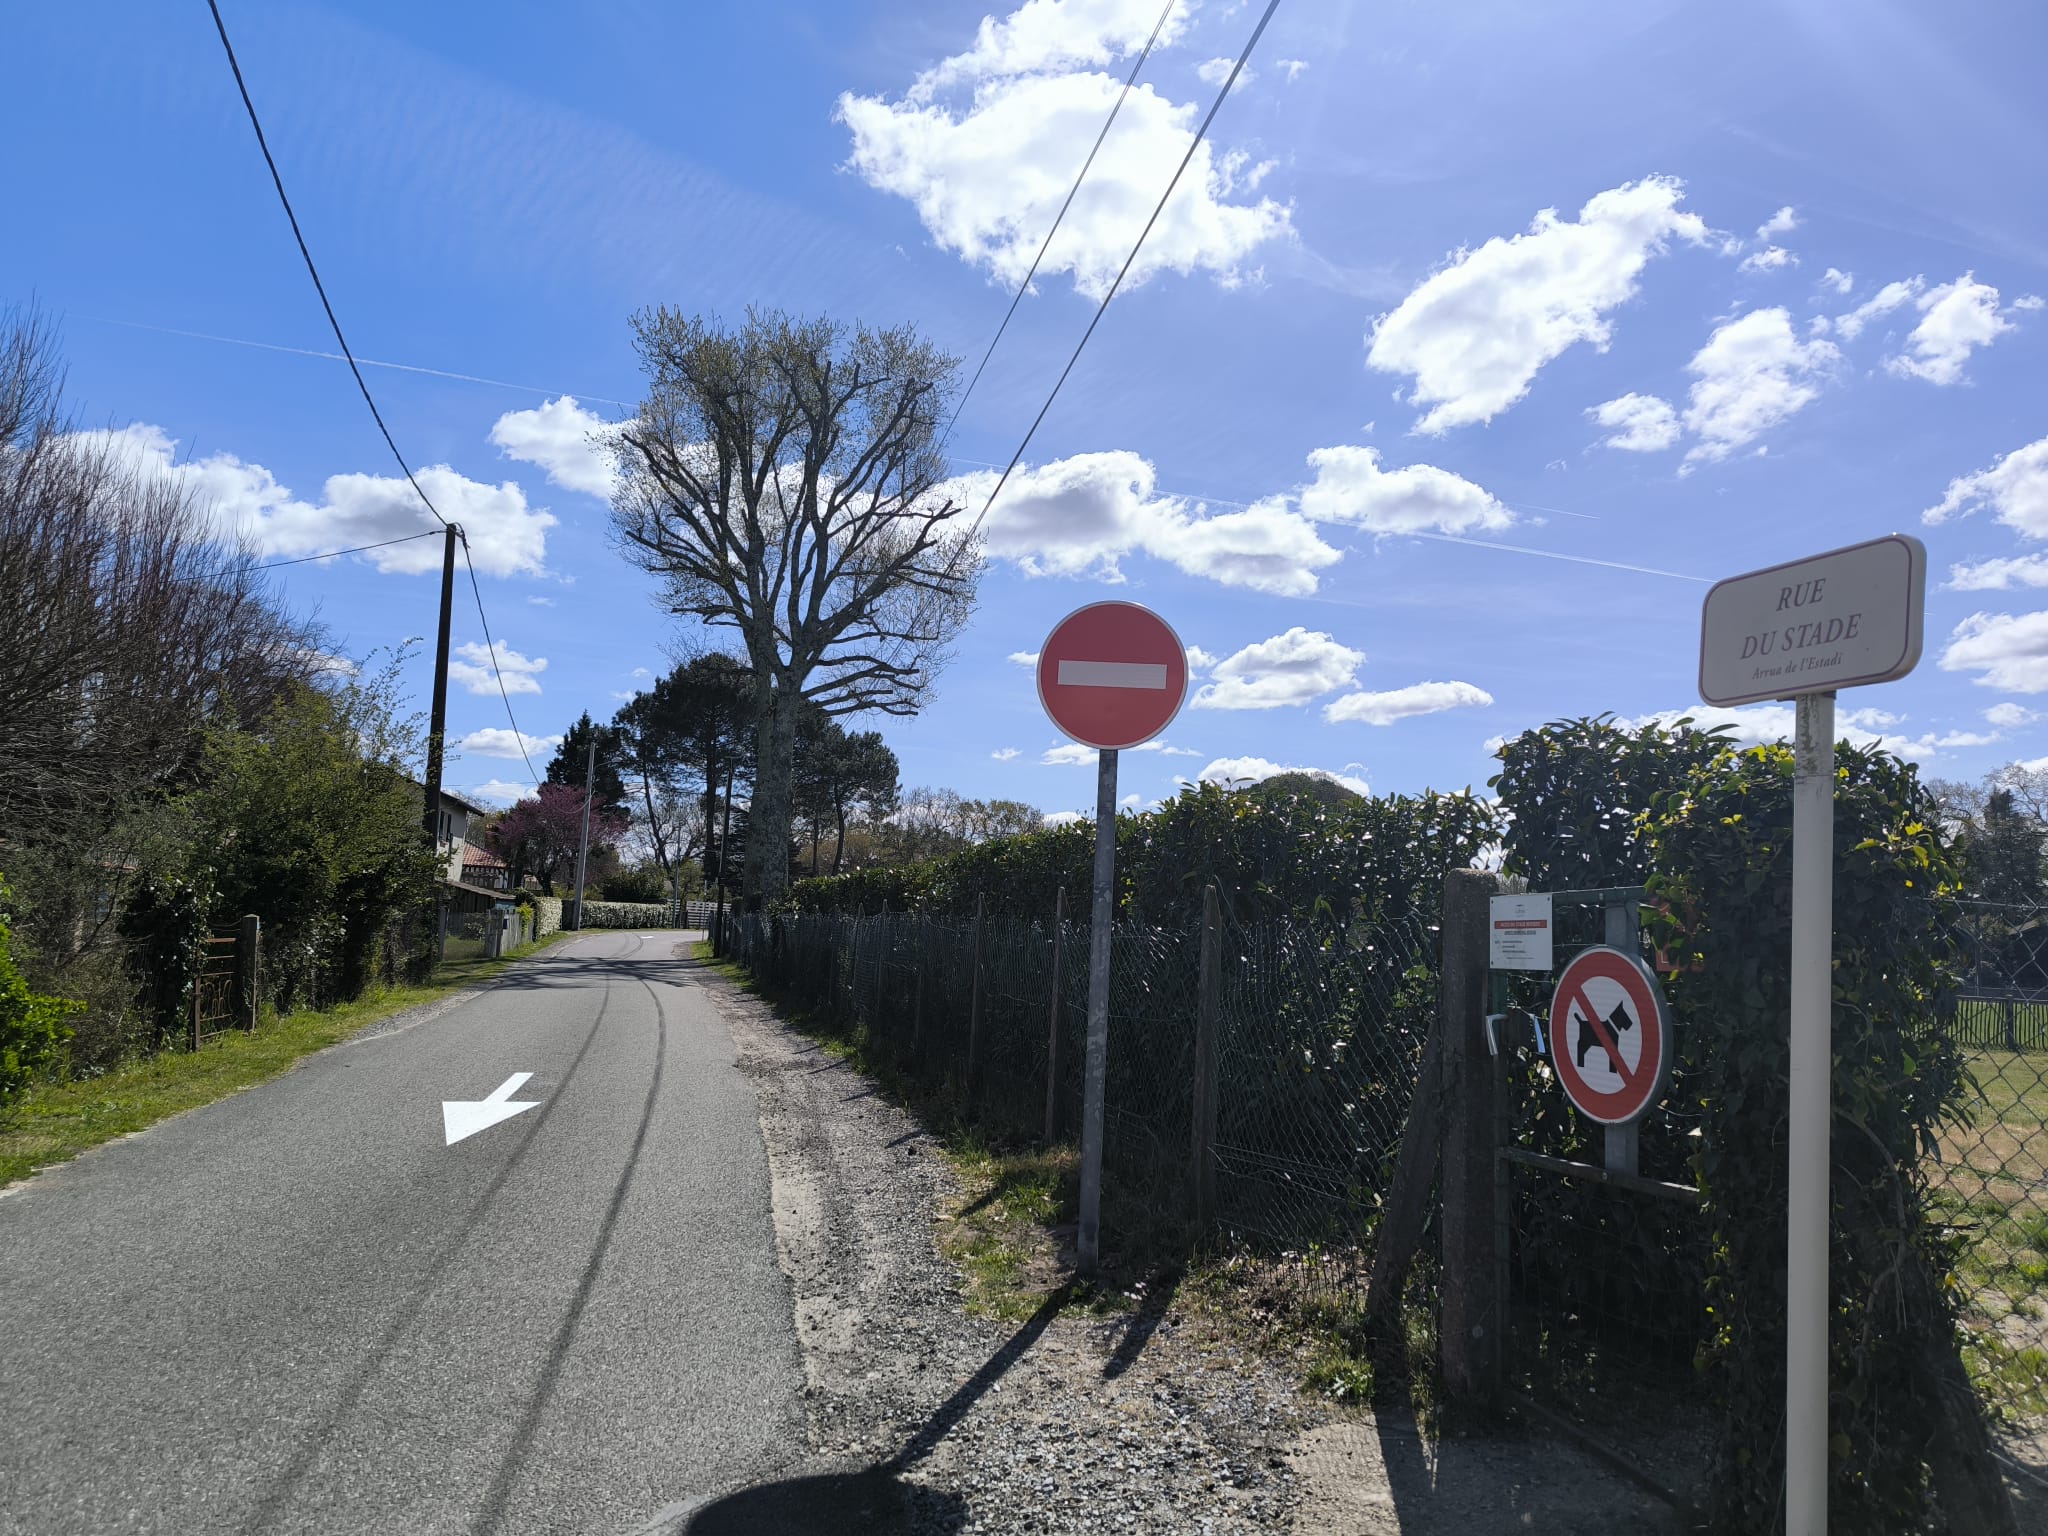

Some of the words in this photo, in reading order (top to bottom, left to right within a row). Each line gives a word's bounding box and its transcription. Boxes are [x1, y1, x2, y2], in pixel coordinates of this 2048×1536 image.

[1776, 578, 1826, 611] RUE
[1740, 631, 1778, 660] DU
[1781, 613, 1862, 652] STADE
[1751, 667, 1782, 680] Arrua
[1785, 660, 1797, 674] de
[1799, 652, 1843, 672] l'Estadi
